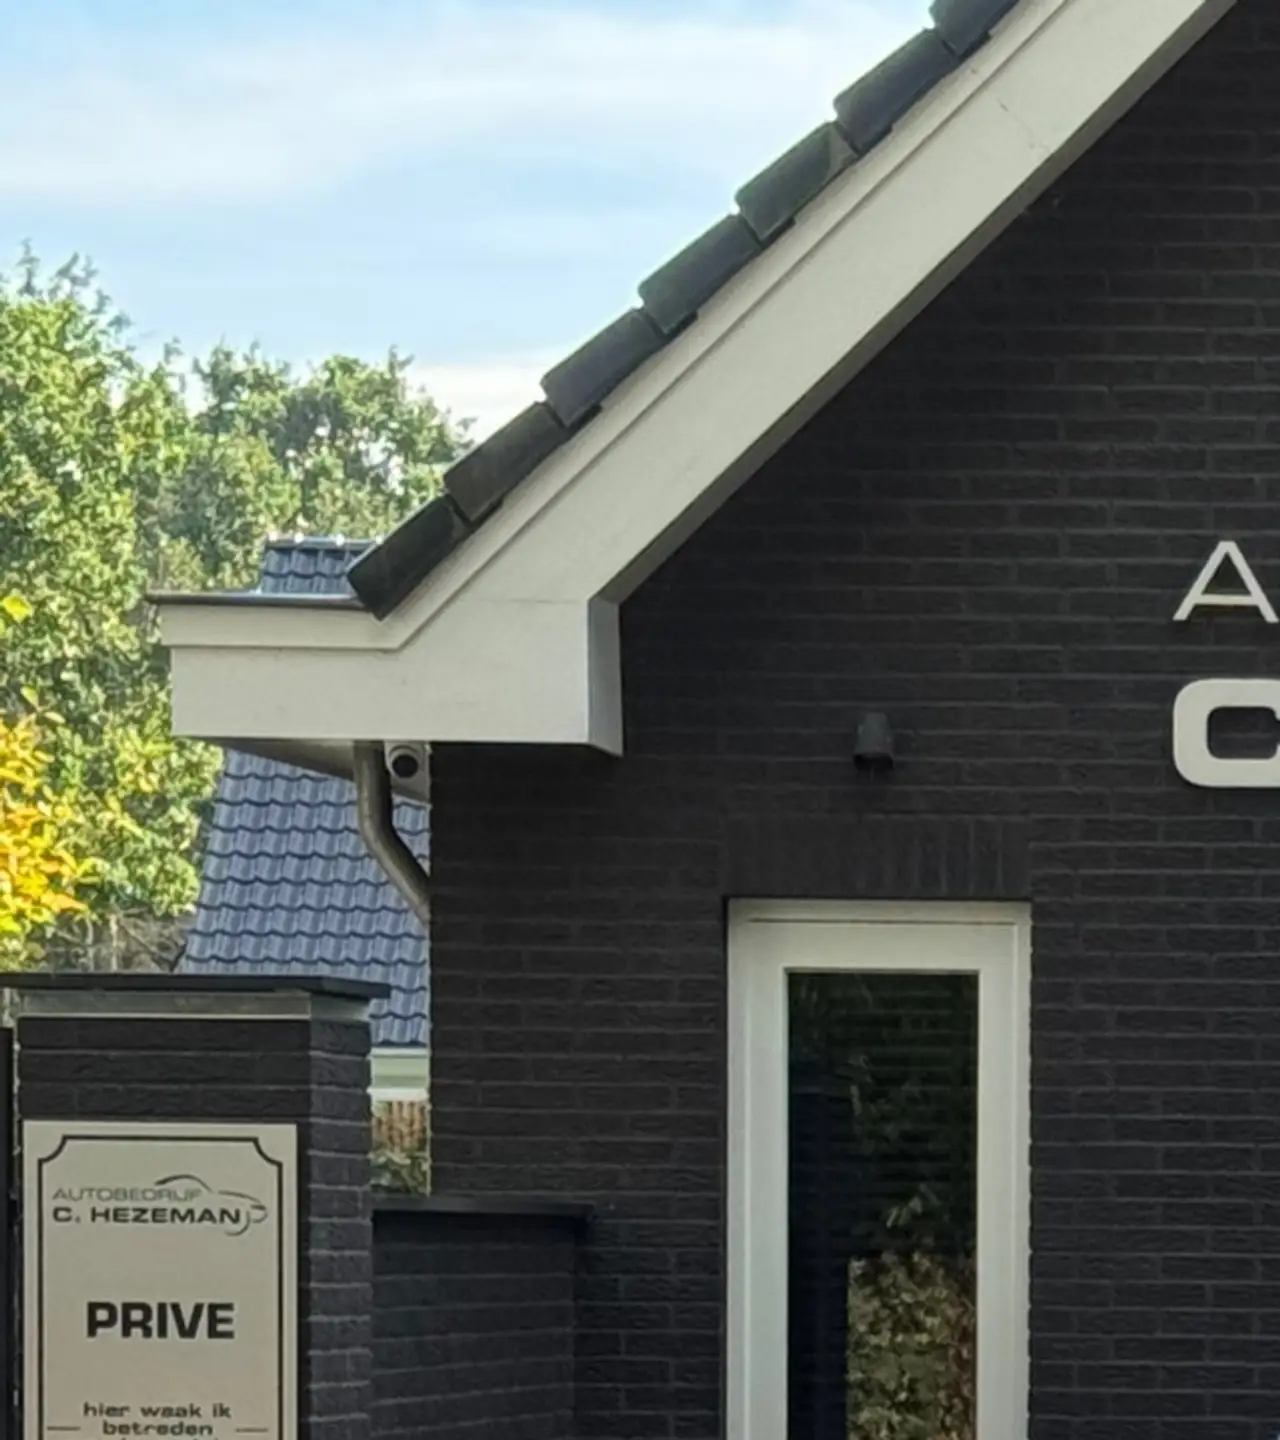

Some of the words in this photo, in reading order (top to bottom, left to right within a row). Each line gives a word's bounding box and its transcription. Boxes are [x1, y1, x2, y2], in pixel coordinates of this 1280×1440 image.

[52, 1187, 203, 1202] AUTOBEDRIJF
[52, 1206, 82, 1224] C.
[90, 1206, 242, 1224] HEZEMAN
[87, 1301, 236, 1340] PRIVE
[83, 1402, 130, 1419] hier
[140, 1403, 202, 1419] waak
[212, 1402, 231, 1419] ik
[102, 1420, 213, 1436] betreden
